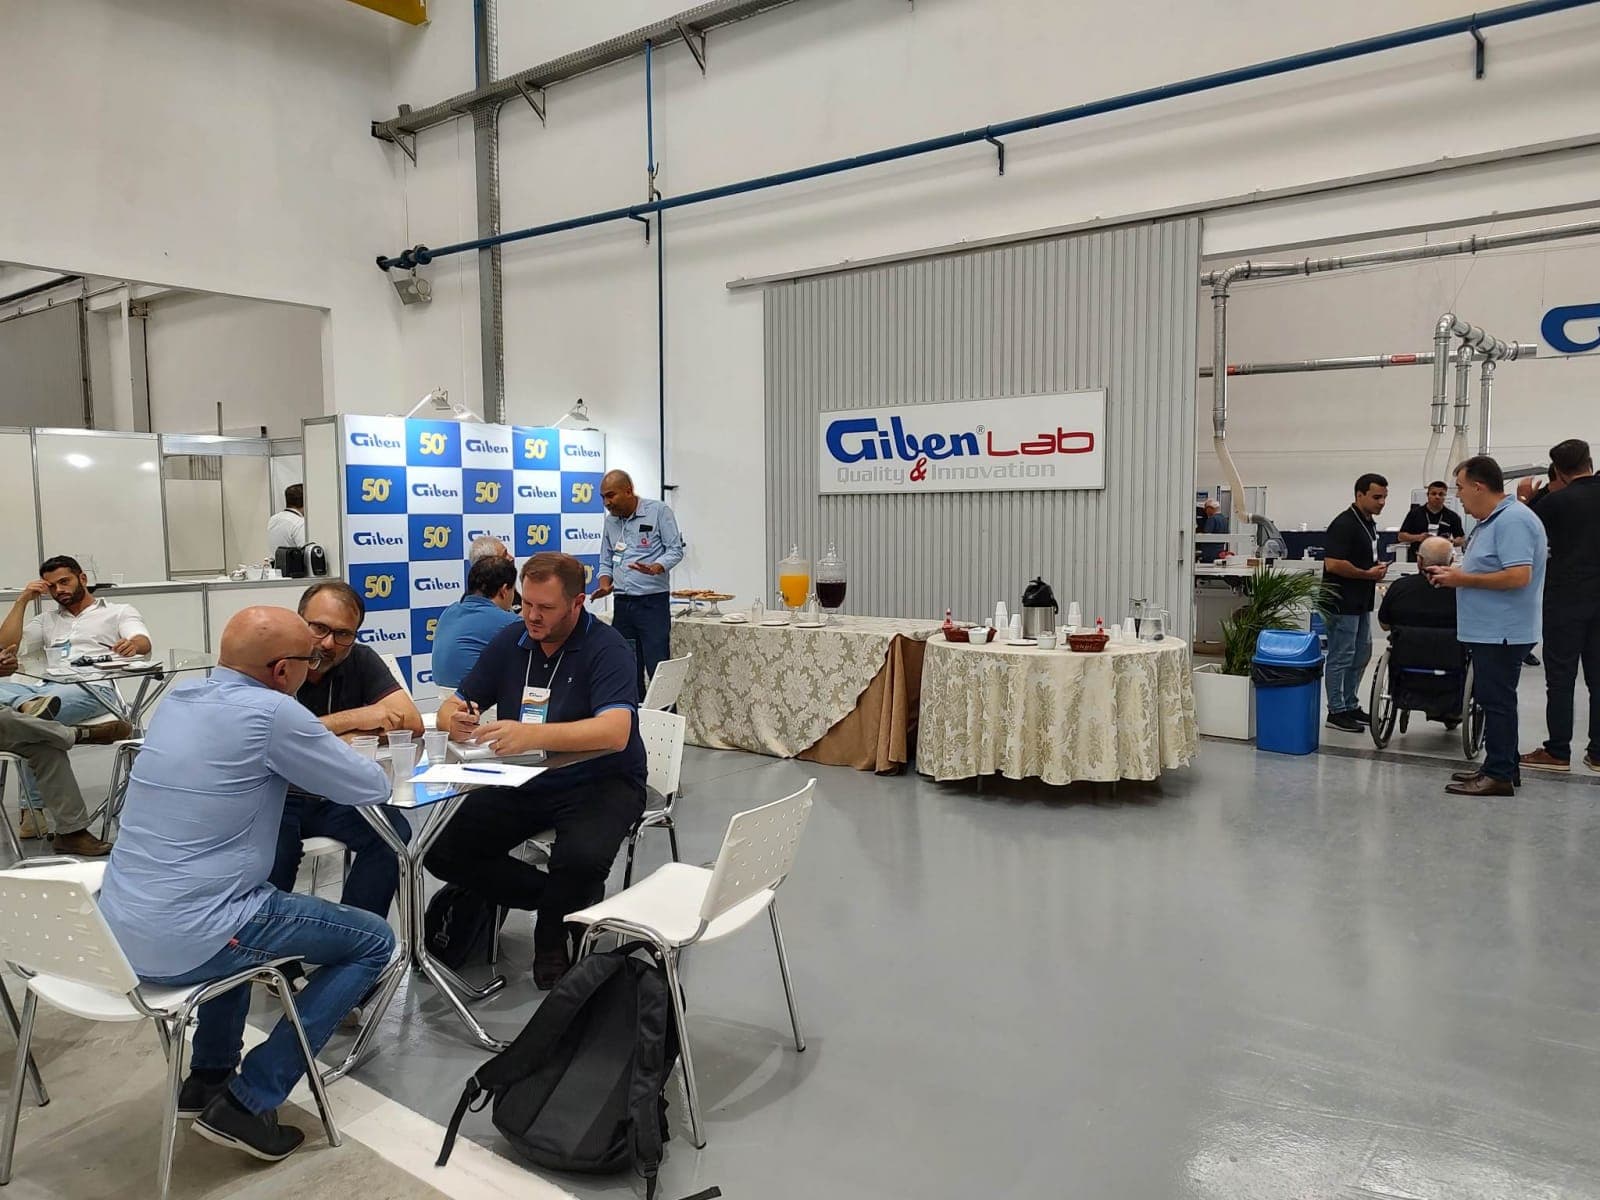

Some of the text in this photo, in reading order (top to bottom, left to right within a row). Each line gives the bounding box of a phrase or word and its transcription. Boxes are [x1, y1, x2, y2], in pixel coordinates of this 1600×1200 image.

[350, 432, 401, 449] Giben
[465, 439, 509, 455] Giben
[987, 427, 1095, 457] Lab
[564, 444, 601, 458] Giben
[836, 458, 1056, 485] Quality & Innovation
[412, 483, 459, 498] Giben
[518, 485, 557, 499] Giben
[353, 531, 404, 547] Giben
[565, 528, 602, 541] Giben
[414, 577, 460, 591] Giben
[357, 628, 407, 643] Giben
